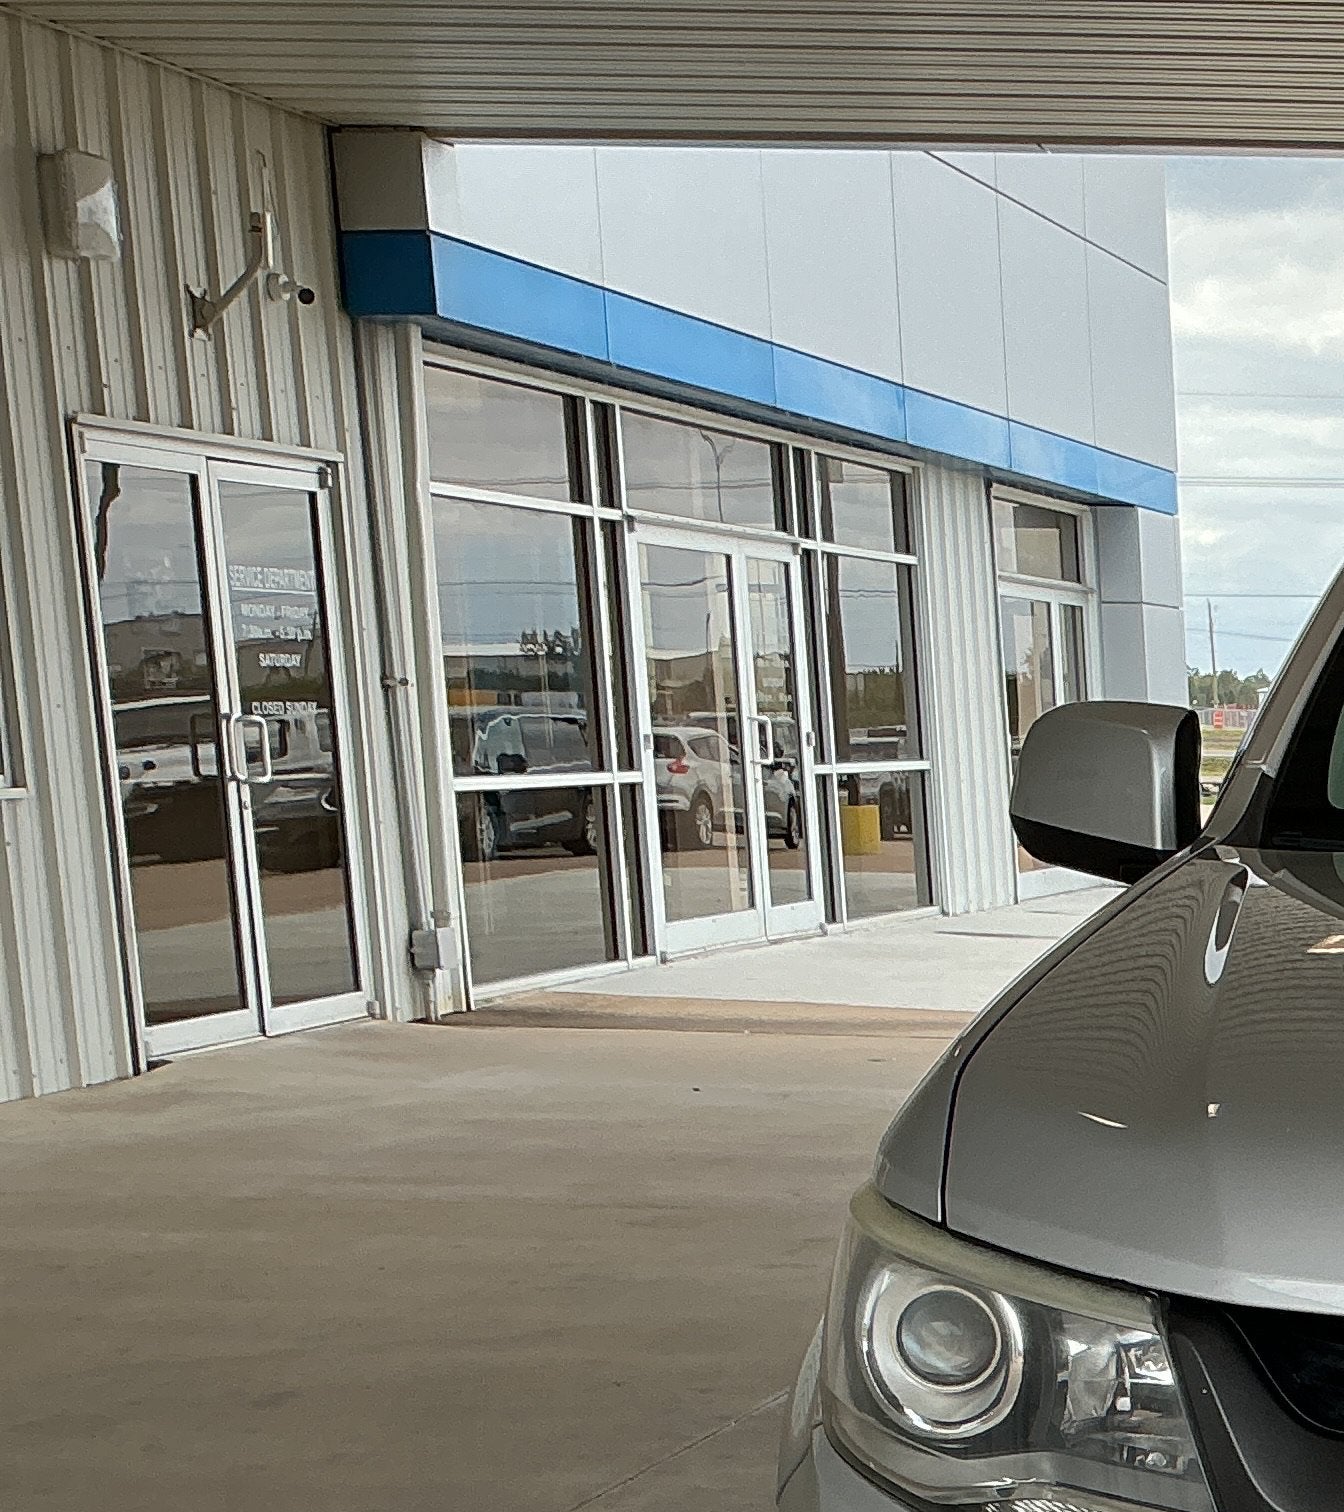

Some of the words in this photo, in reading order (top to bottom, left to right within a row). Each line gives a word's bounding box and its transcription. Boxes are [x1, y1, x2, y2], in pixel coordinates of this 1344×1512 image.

[228, 565, 262, 588] SERVICE
[263, 567, 316, 591] DEPARTMENT
[240, 604, 275, 619] MONDAY
[281, 605, 310, 619] FRIDAY
[258, 653, 302, 667] SATURDAY
[252, 701, 285, 714] CLOSED
[285, 701, 318, 715] SUNDAY
